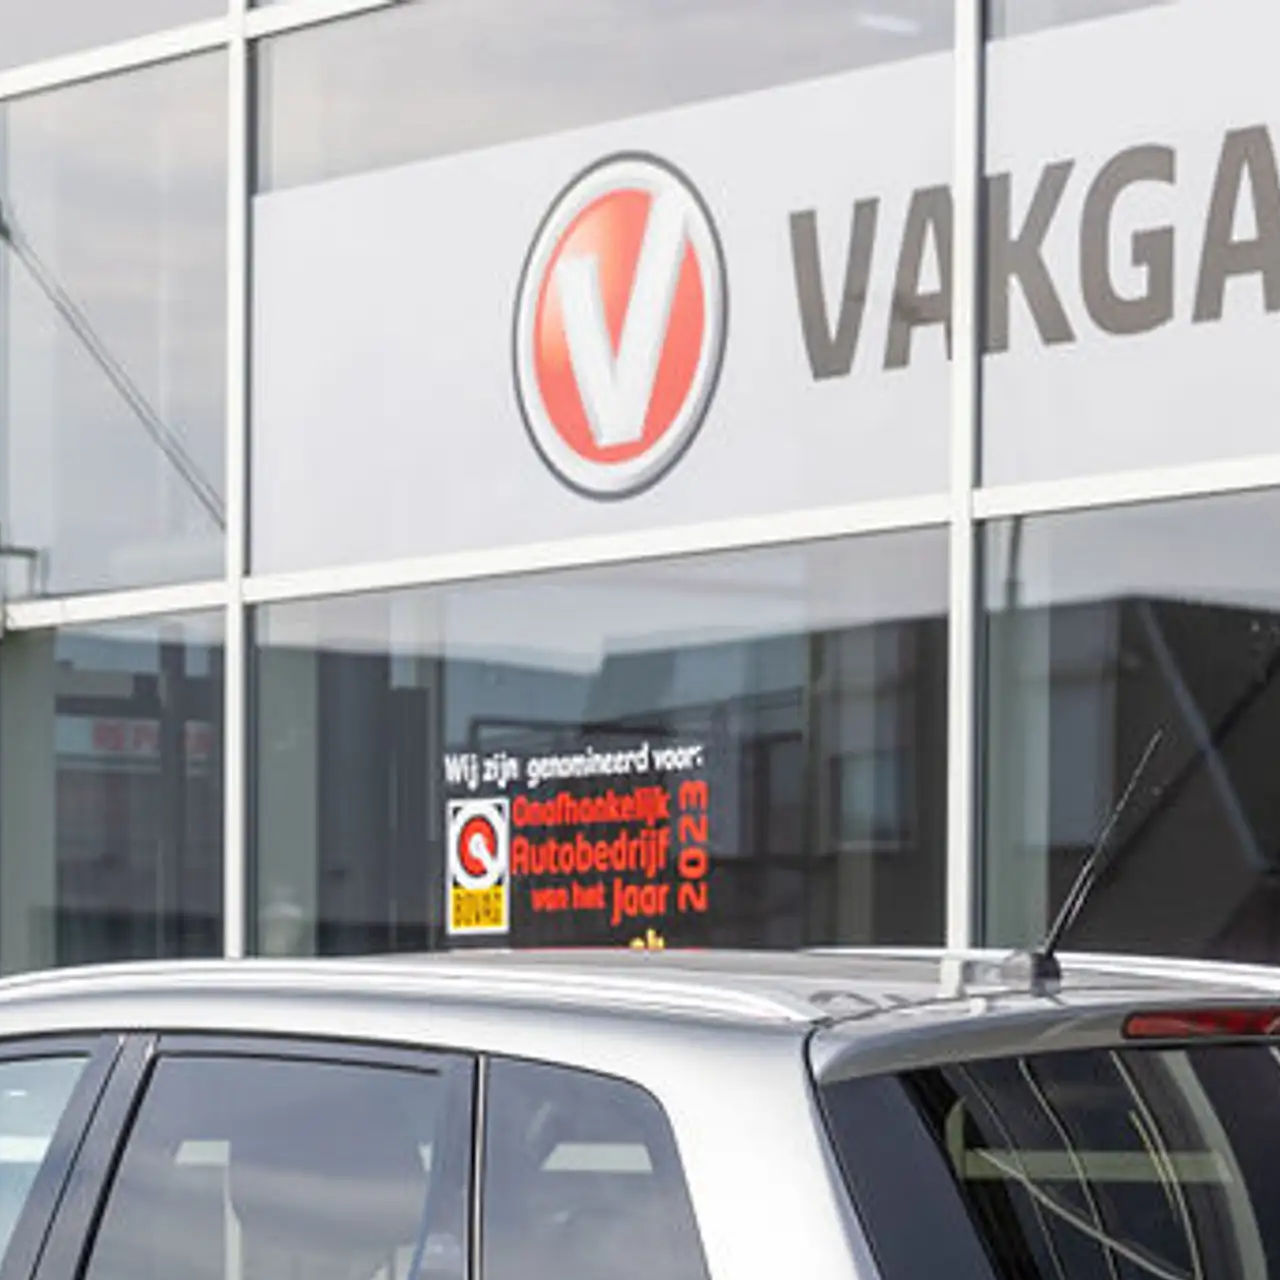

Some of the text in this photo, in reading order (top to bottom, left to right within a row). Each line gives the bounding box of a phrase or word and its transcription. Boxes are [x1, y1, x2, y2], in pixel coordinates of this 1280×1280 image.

[444, 742, 703, 790] Wij zijn genomineerd voor:
[510, 826, 671, 878] Autobedrijf
[677, 780, 709, 912] 2023
[531, 888, 568, 911] van
